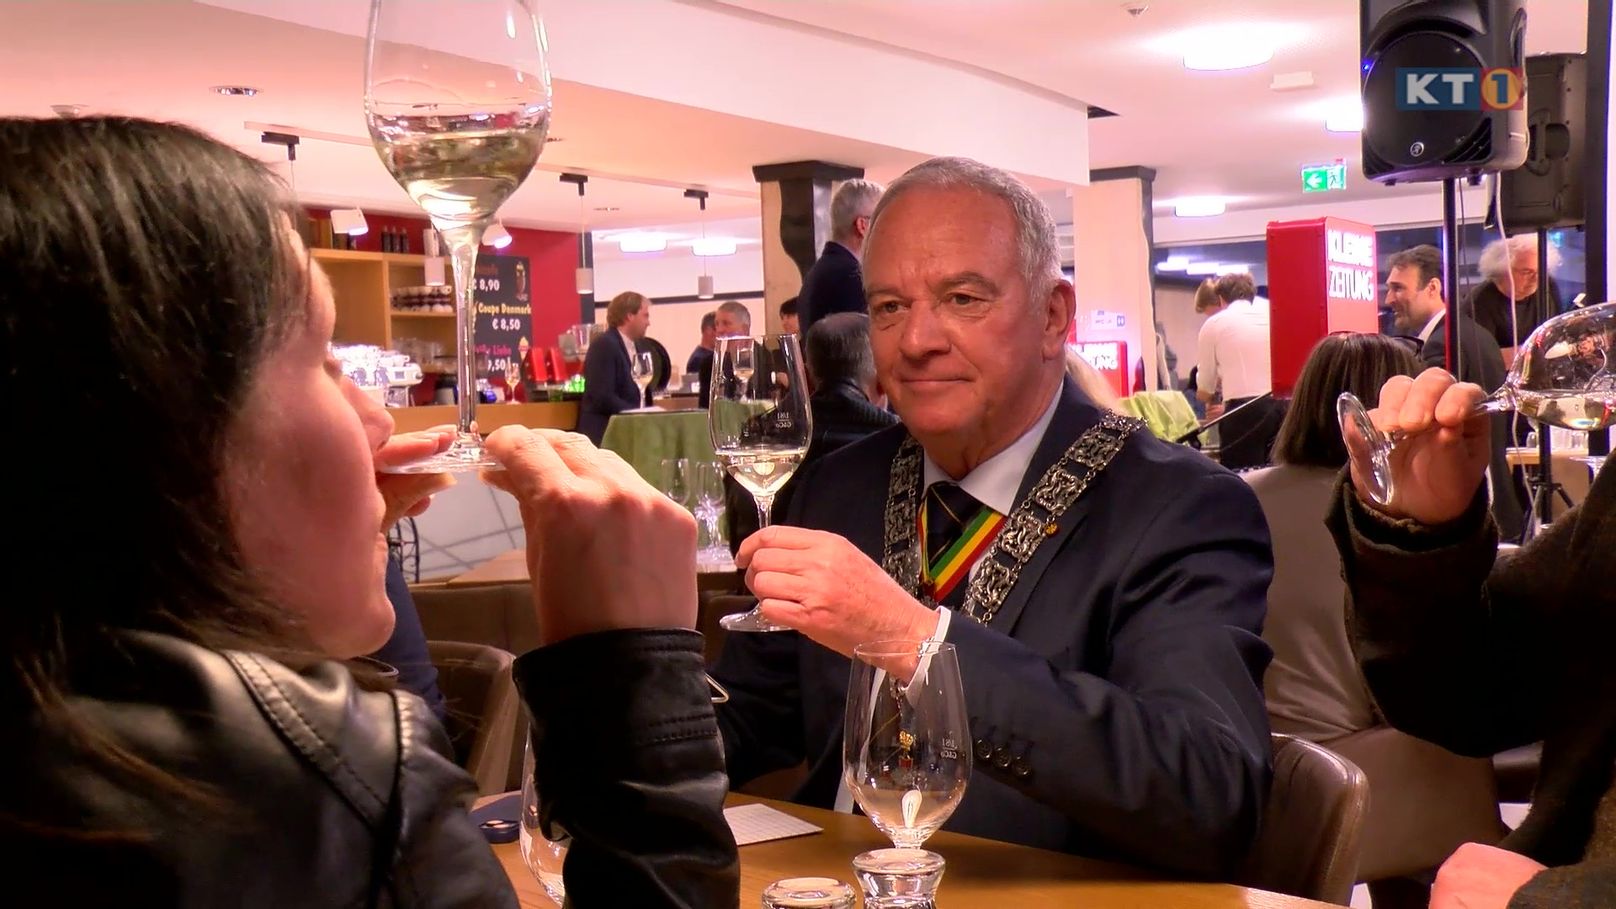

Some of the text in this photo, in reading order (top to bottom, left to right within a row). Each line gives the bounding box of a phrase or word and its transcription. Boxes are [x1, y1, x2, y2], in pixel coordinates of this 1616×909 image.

[479, 279, 500, 292] 8,90
[1328, 265, 1374, 301] ZEITUNG
[492, 318, 521, 331] € 8,50
